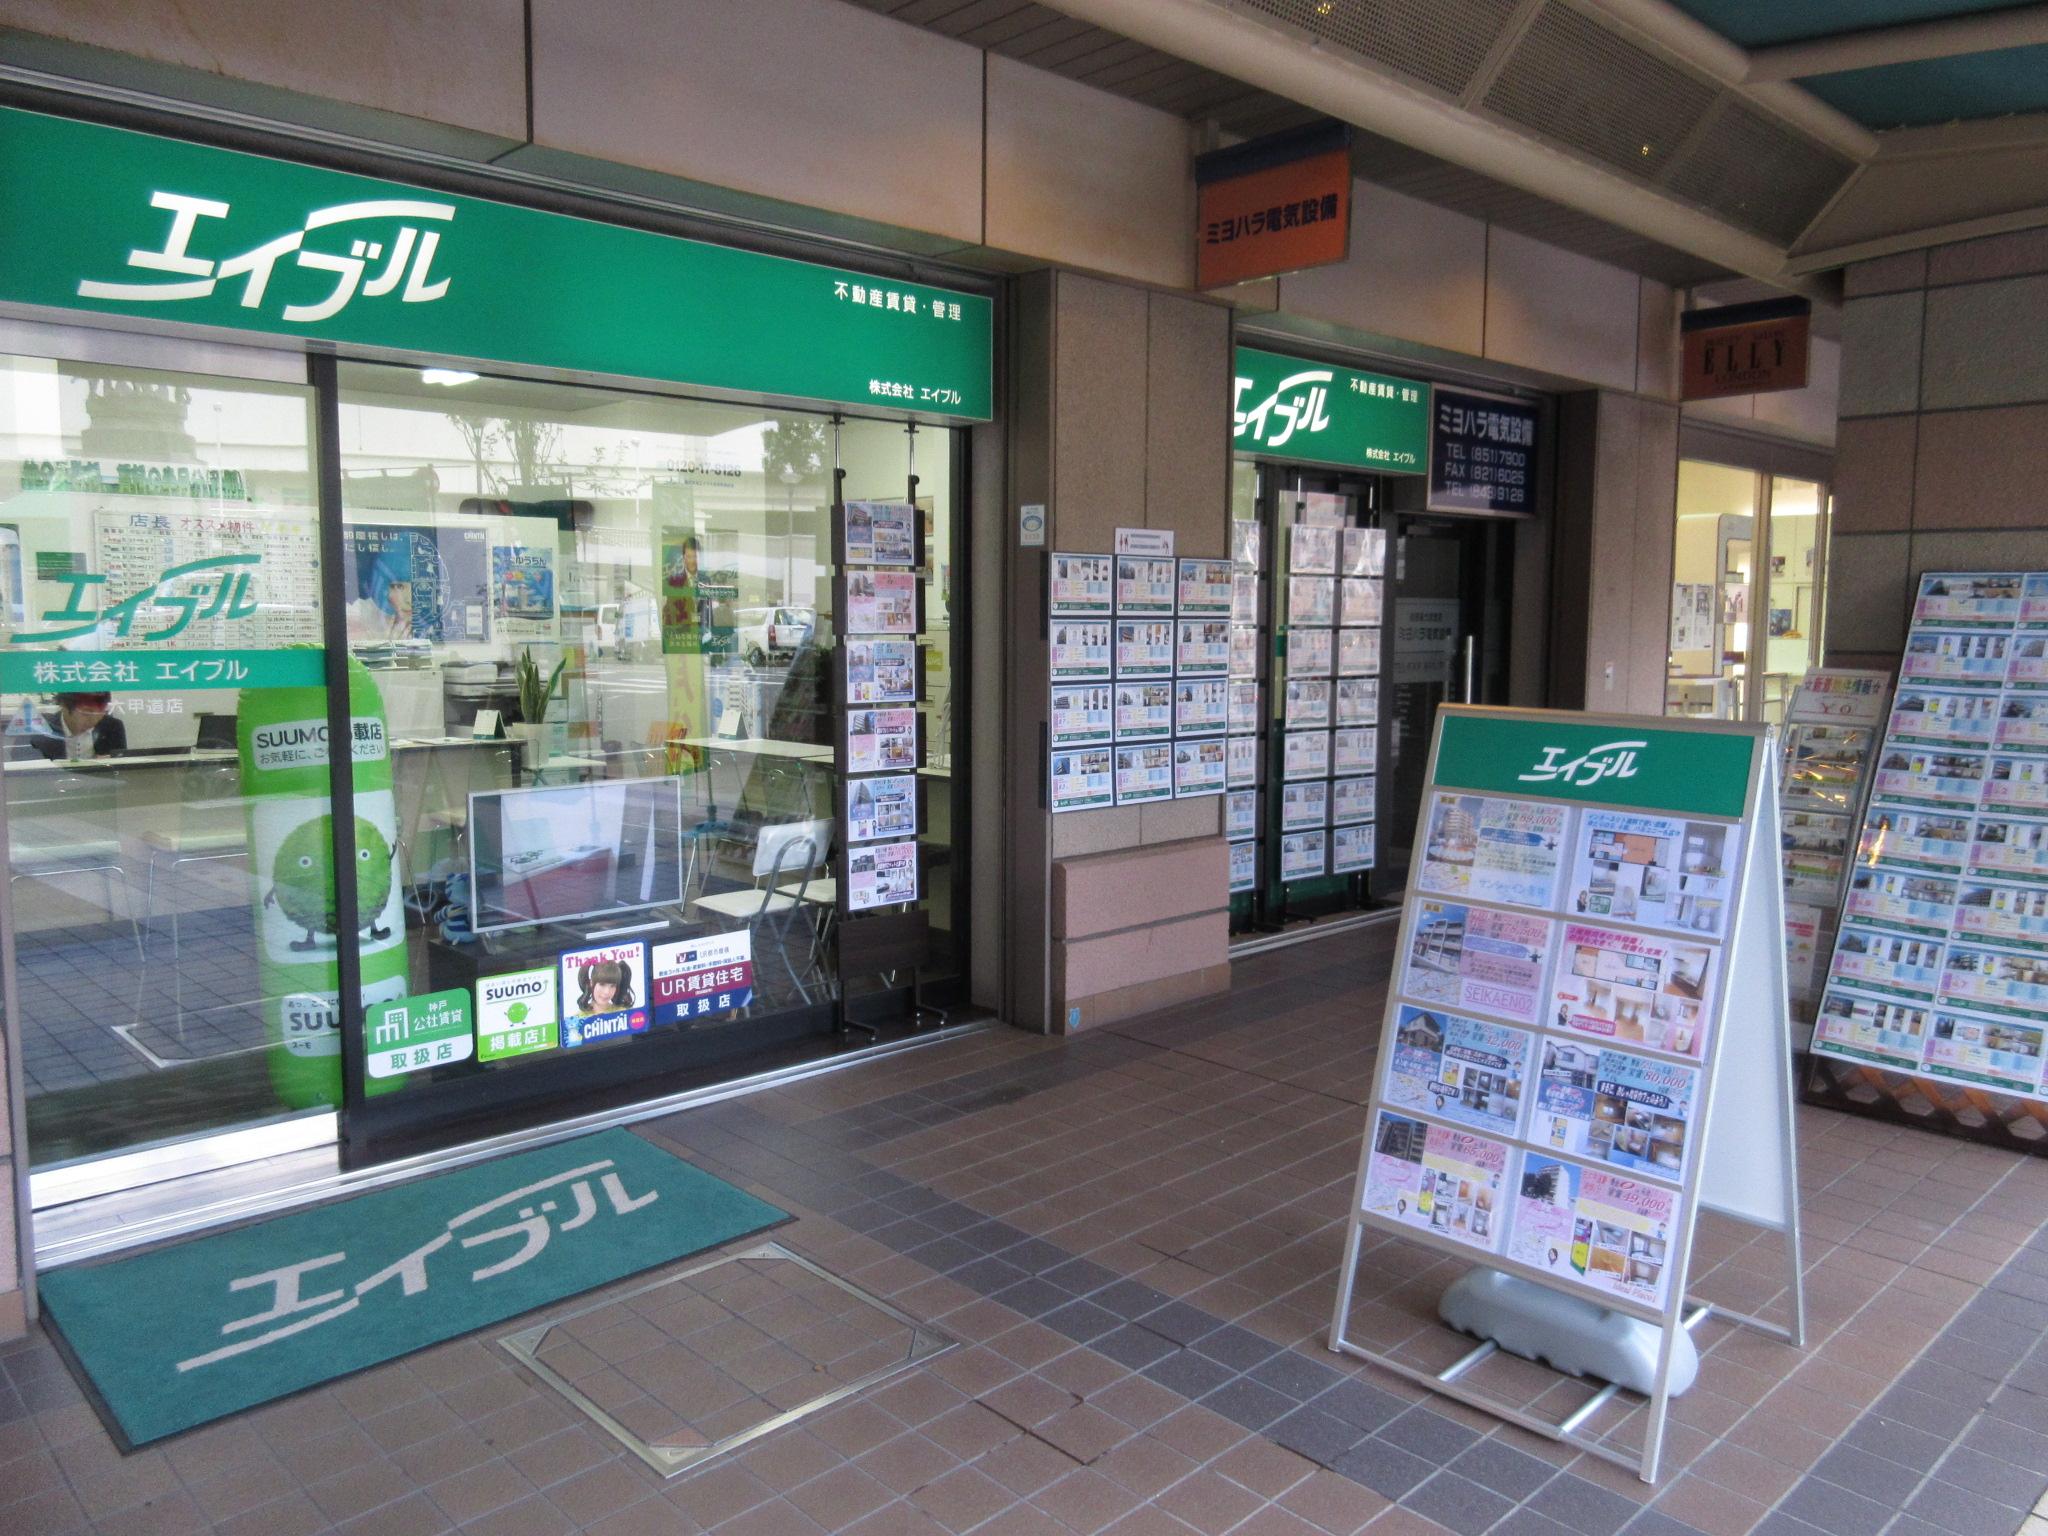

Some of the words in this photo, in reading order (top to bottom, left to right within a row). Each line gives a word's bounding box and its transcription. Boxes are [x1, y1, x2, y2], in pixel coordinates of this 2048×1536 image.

[1206, 193, 1338, 245] ミヨハラ電気設備
[78, 191, 456, 322] エイブル
[834, 280, 962, 321] 不動産賃貸・管理
[869, 379, 914, 399] 株式会社
[920, 387, 961, 405] エイブル
[1439, 404, 1534, 447] ミヨハラ電気設備
[1366, 447, 1390, 461] 株式会社
[1393, 451, 1416, 465] エイブル
[1446, 443, 1466, 460] TEL
[1445, 461, 1466, 477] FAX
[9, 554, 261, 643] エイブル
[33, 660, 140, 684] 株式会社
[156, 659, 249, 682] エイブル
[108, 698, 184, 716] 六甲道店
[1518, 740, 1648, 786] エイブル
[610, 946, 640, 962] You!
[661, 966, 744, 997] UR賃貸住宅
[428, 999, 448, 1012] 神戸
[676, 994, 731, 1017] 取扱店
[1465, 985, 1534, 1012] SEIKAEN02
[414, 1009, 464, 1031] 公社賃貸
[390, 1042, 453, 1070] 取扱店
[175, 1159, 660, 1373] エイブル
